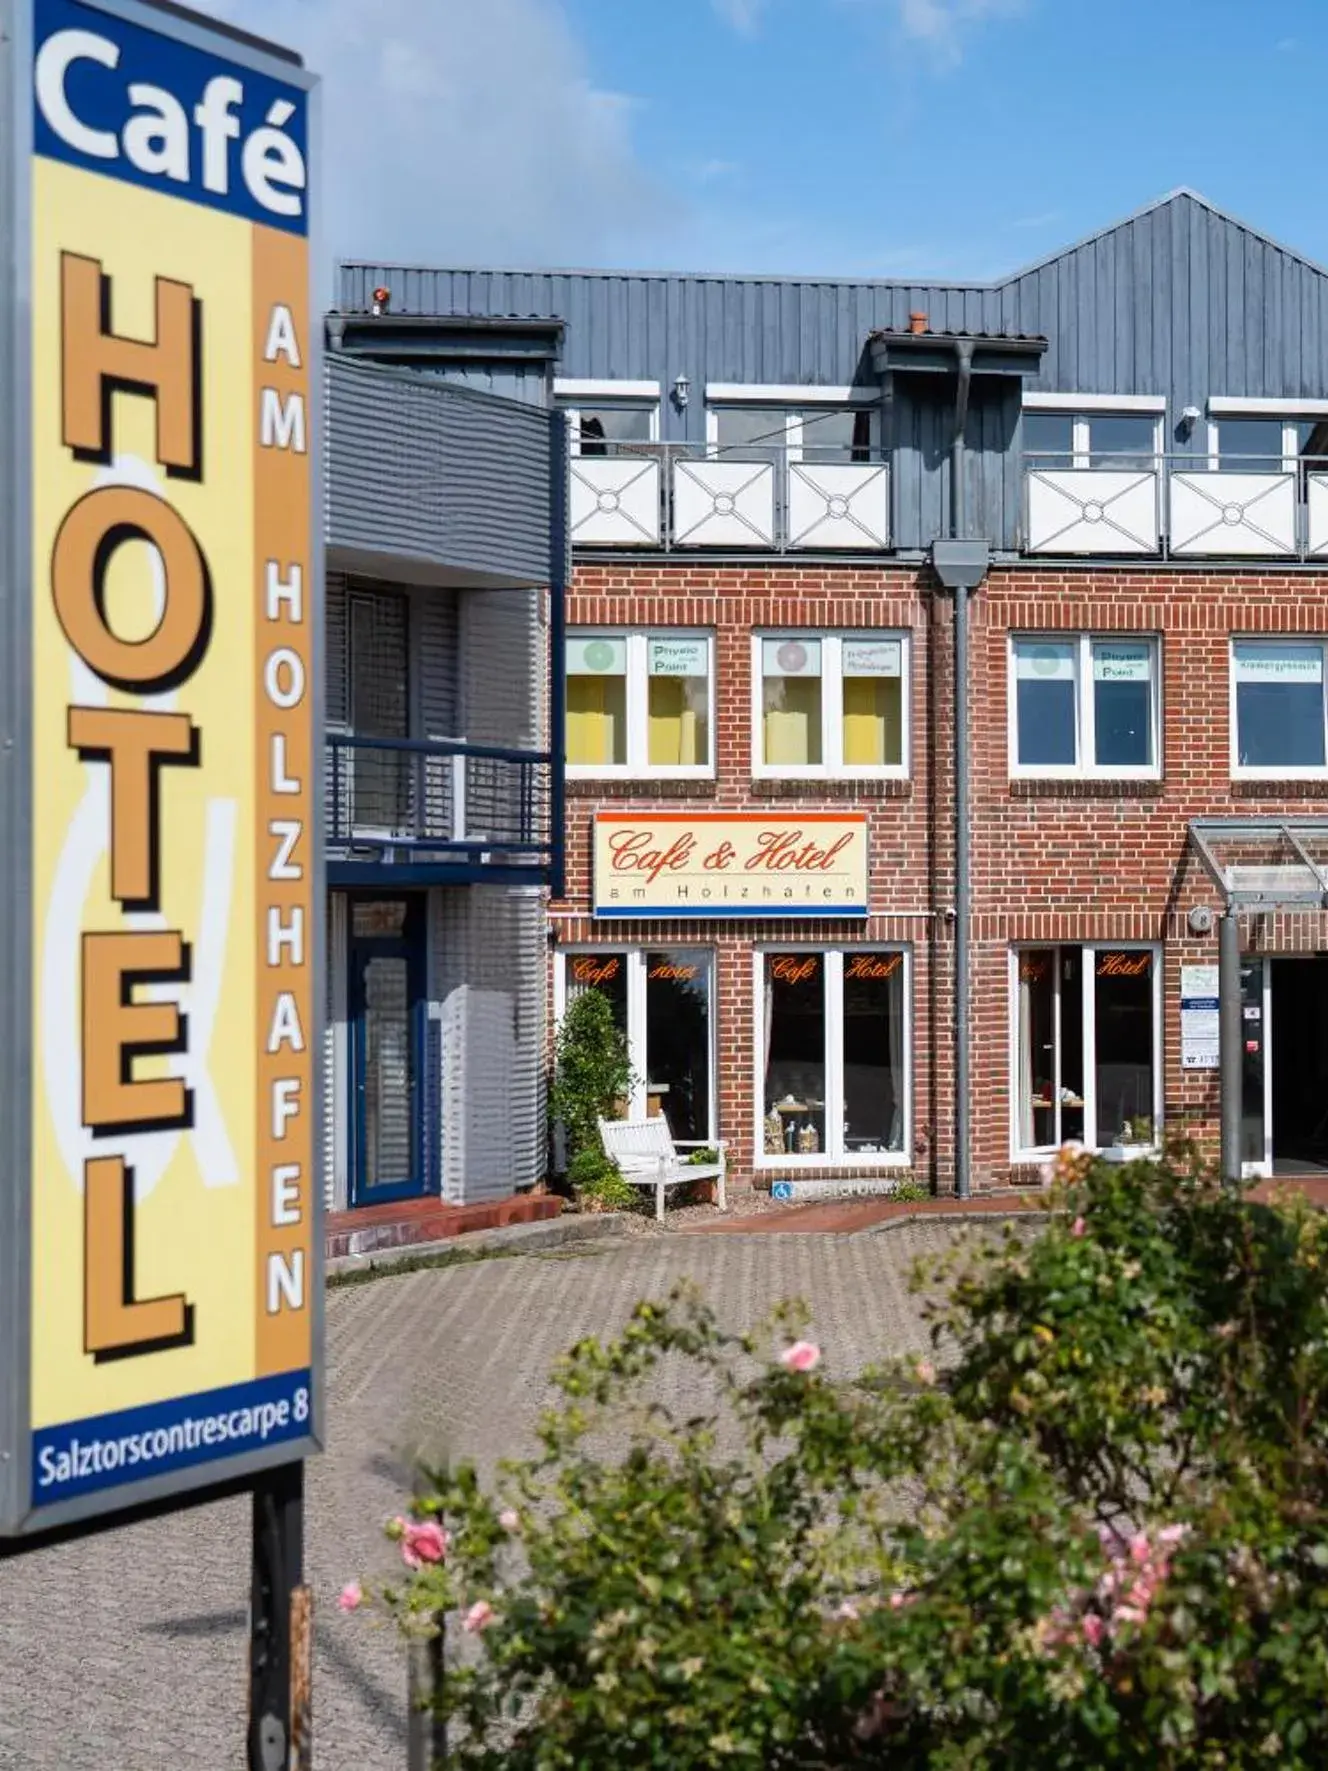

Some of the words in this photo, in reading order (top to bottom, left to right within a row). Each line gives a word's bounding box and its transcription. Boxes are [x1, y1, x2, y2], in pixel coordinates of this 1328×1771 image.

[33, 28, 307, 216] Café
[259, 304, 307, 454] AM
[51, 249, 214, 1364] HOTEL
[608, 830, 696, 884] Café
[703, 841, 736, 870] &
[744, 830, 854, 870] Hotel
[263, 559, 307, 1315] HOLZHAFEN
[609, 886, 647, 899] am
[678, 884, 855, 899] Holzhafen
[844, 952, 904, 979] Hotel
[1096, 952, 1151, 976] Hotel
[38, 1395, 290, 1487] Salztorscontrescarpe
[293, 1386, 309, 1422] 8
